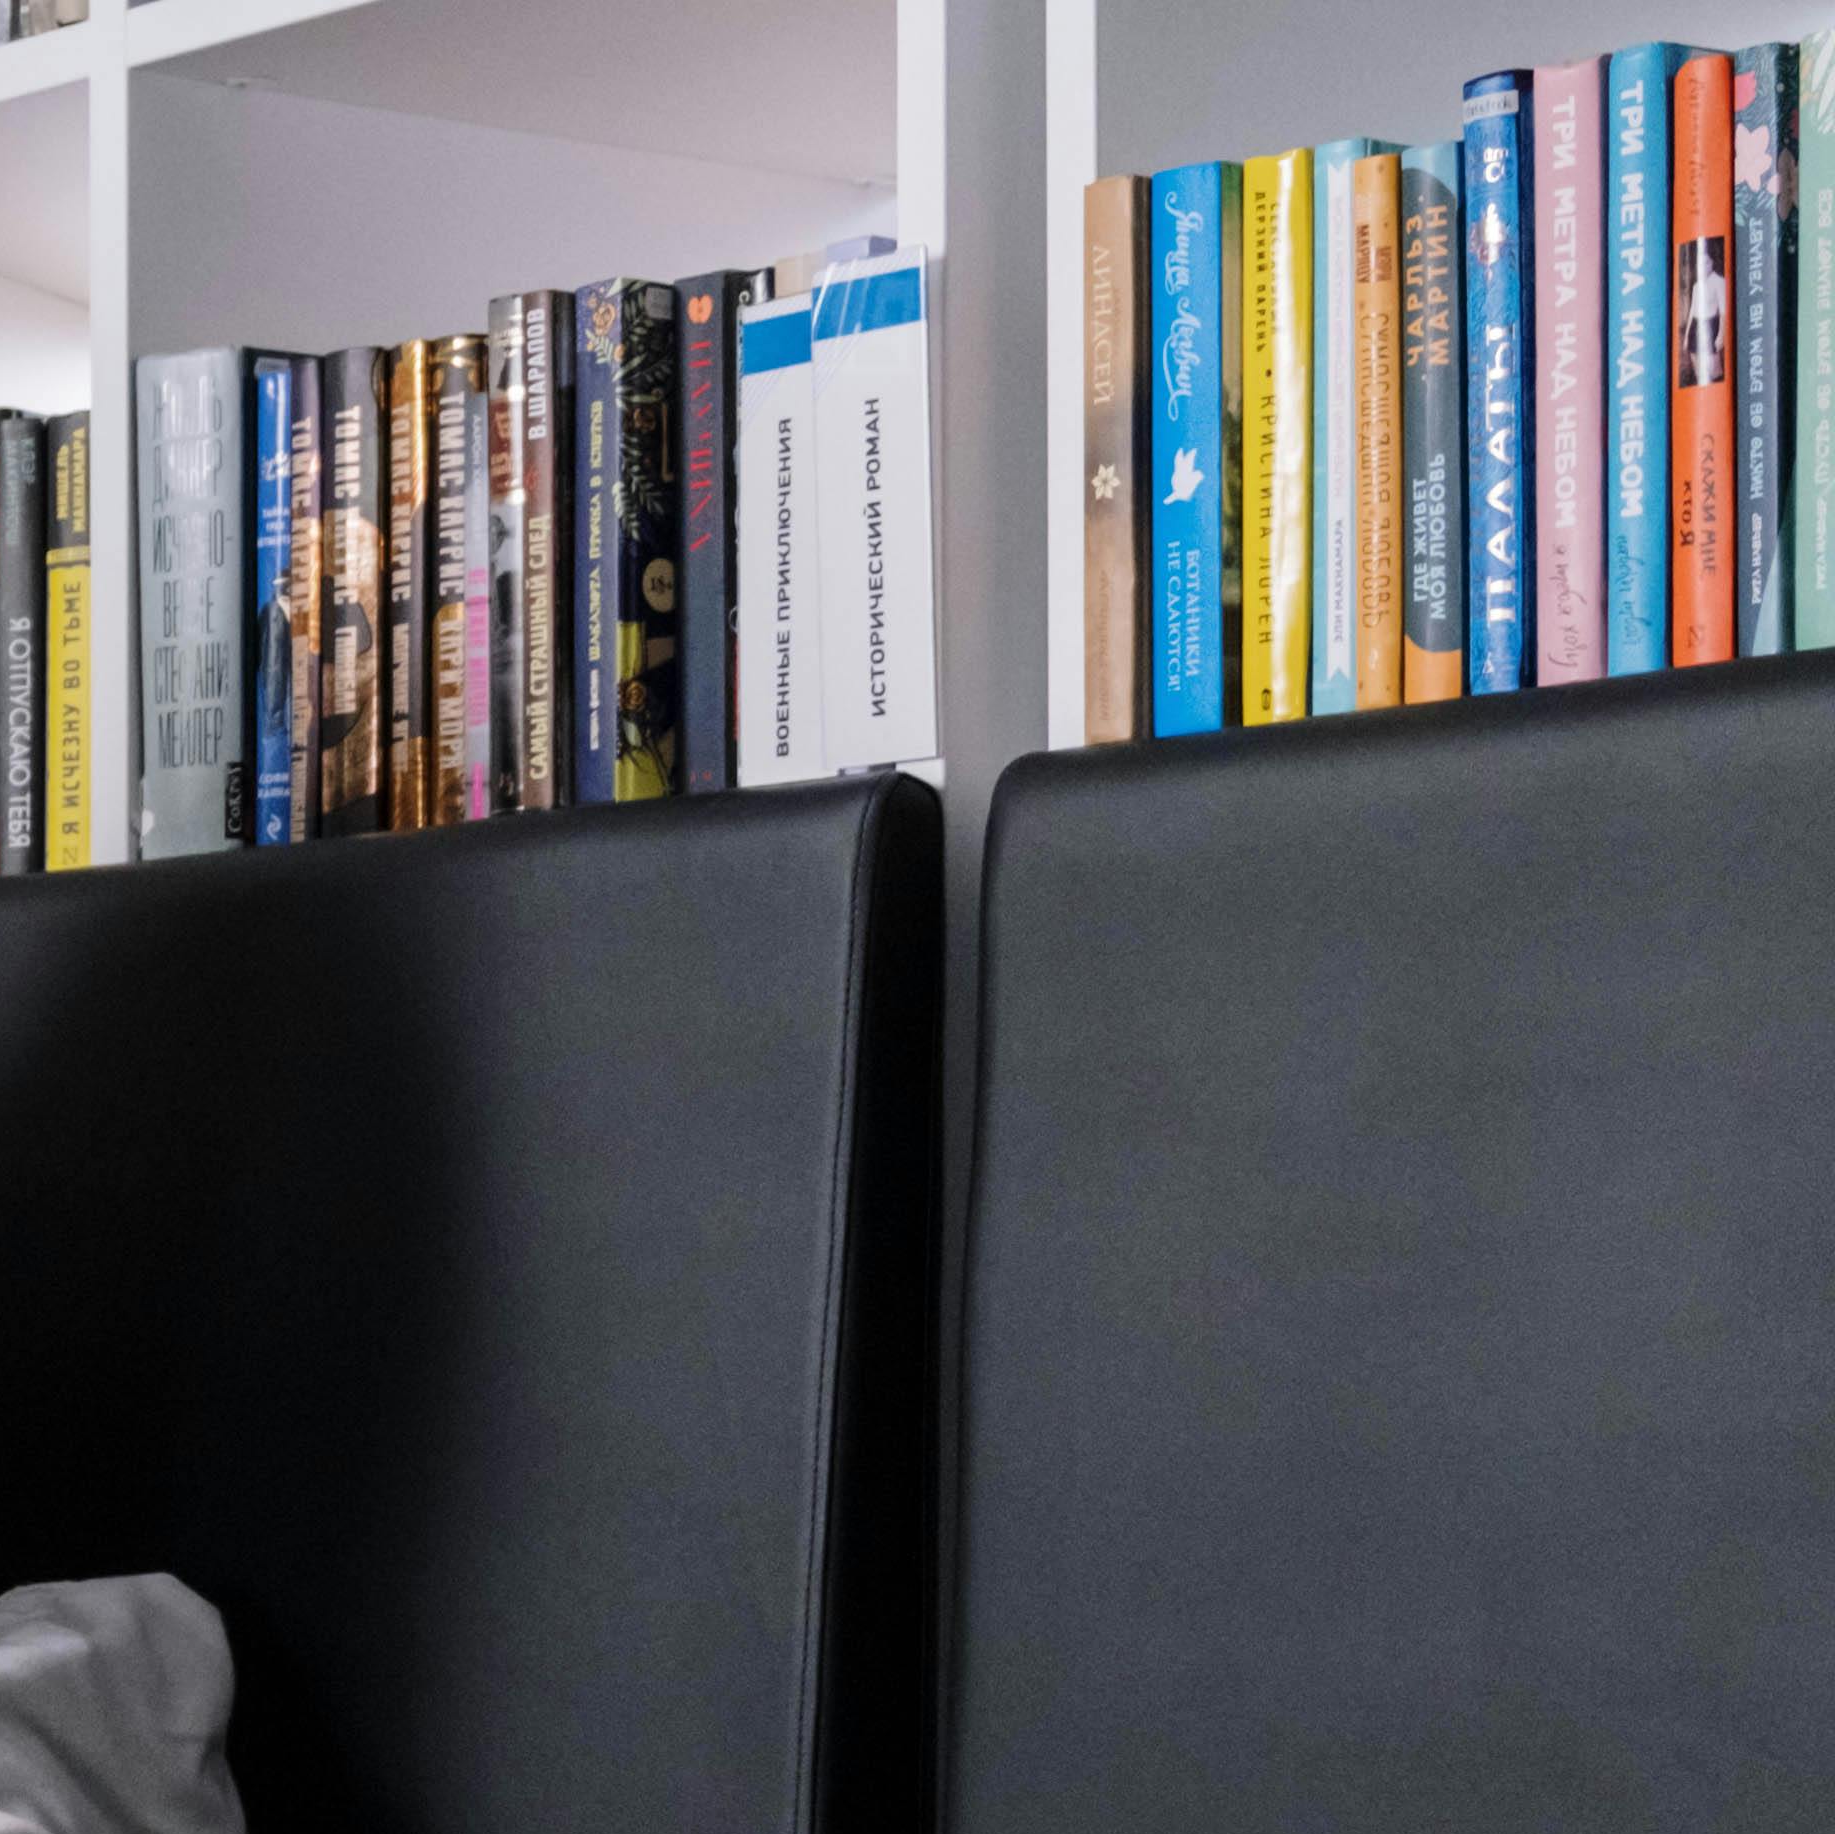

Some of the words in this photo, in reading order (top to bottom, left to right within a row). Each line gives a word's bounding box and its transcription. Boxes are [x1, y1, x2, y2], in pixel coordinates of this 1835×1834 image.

[1552, 95, 1577, 170] ТРИ
[1619, 80, 1644, 156] ТРИ
[1552, 186, 1577, 308] МЕТРА
[1619, 171, 1644, 295] МЕТРА
[1749, 216, 1764, 295] УЗНАЕТ
[1406, 213, 1425, 367] ЧАРЛЬЗ
[1427, 204, 1450, 366] МАРТИН
[1749, 303, 1764, 329] НЕ
[526, 307, 548, 441] В.ШАРАПОВ
[1549, 322, 1577, 402] НАД
[1616, 310, 1645, 390] НАД
[1749, 337, 1764, 393] ЭТОМ
[1817, 319, 1831, 375] ЭТОМ
[1749, 402, 1764, 428] ОБ
[1817, 383, 1831, 411] ОБ
[333, 404, 361, 500] ТОМАС
[391, 401, 411, 497] ТОМАС
[438, 390, 465, 488] ТОМАС
[864, 396, 883, 491] РОМАН
[1553, 406, 1577, 529] НЕБОМ
[1619, 394, 1644, 518] НЕБОМ
[1701, 433, 1716, 523] СКАЖИ
[1749, 436, 1764, 500] НИКТО
[1815, 419, 1831, 485] ПУСТЬ
[438, 494, 465, 597] ХАРРИС
[528, 513, 551, 569] СЛЕД
[775, 417, 793, 621] ПРИКЛЮЧЕНИЯ
[1412, 478, 1428, 556] ЖИВЕТ
[1429, 453, 1446, 559] ЛЮБОВЬ
[1679, 529, 1694, 547] Я
[390, 502, 411, 603] ХАРРИС
[1166, 540, 1180, 572] НЕ
[1413, 562, 1430, 602] ГДЕ
[1429, 564, 1447, 620] МОЯ
[1699, 529, 1716, 577] МНЕ
[9, 616, 32, 632] Я
[62, 581, 82, 646] ТЬМЕ
[525, 573, 548, 695] СТРАШНЫЙ
[863, 500, 888, 717] ИСТОРИЧЕСКИЙ
[1166, 575, 1182, 693] СДАЮТСЯ!
[1184, 549, 1201, 677] БОТАНИКИ
[63, 658, 80, 688] ВО
[438, 618, 464, 688] КАРИ
[8, 638, 31, 787] ОТПУСКАЮ
[775, 629, 792, 758] ВОЕННЫЕ
[62, 703, 80, 808] ИСЧЕЗНУ
[438, 697, 464, 770] МОРА
[525, 700, 548, 779] САМЫЙ
[8, 792, 31, 849] ТЕБЯ
[62, 821, 80, 835] Я
